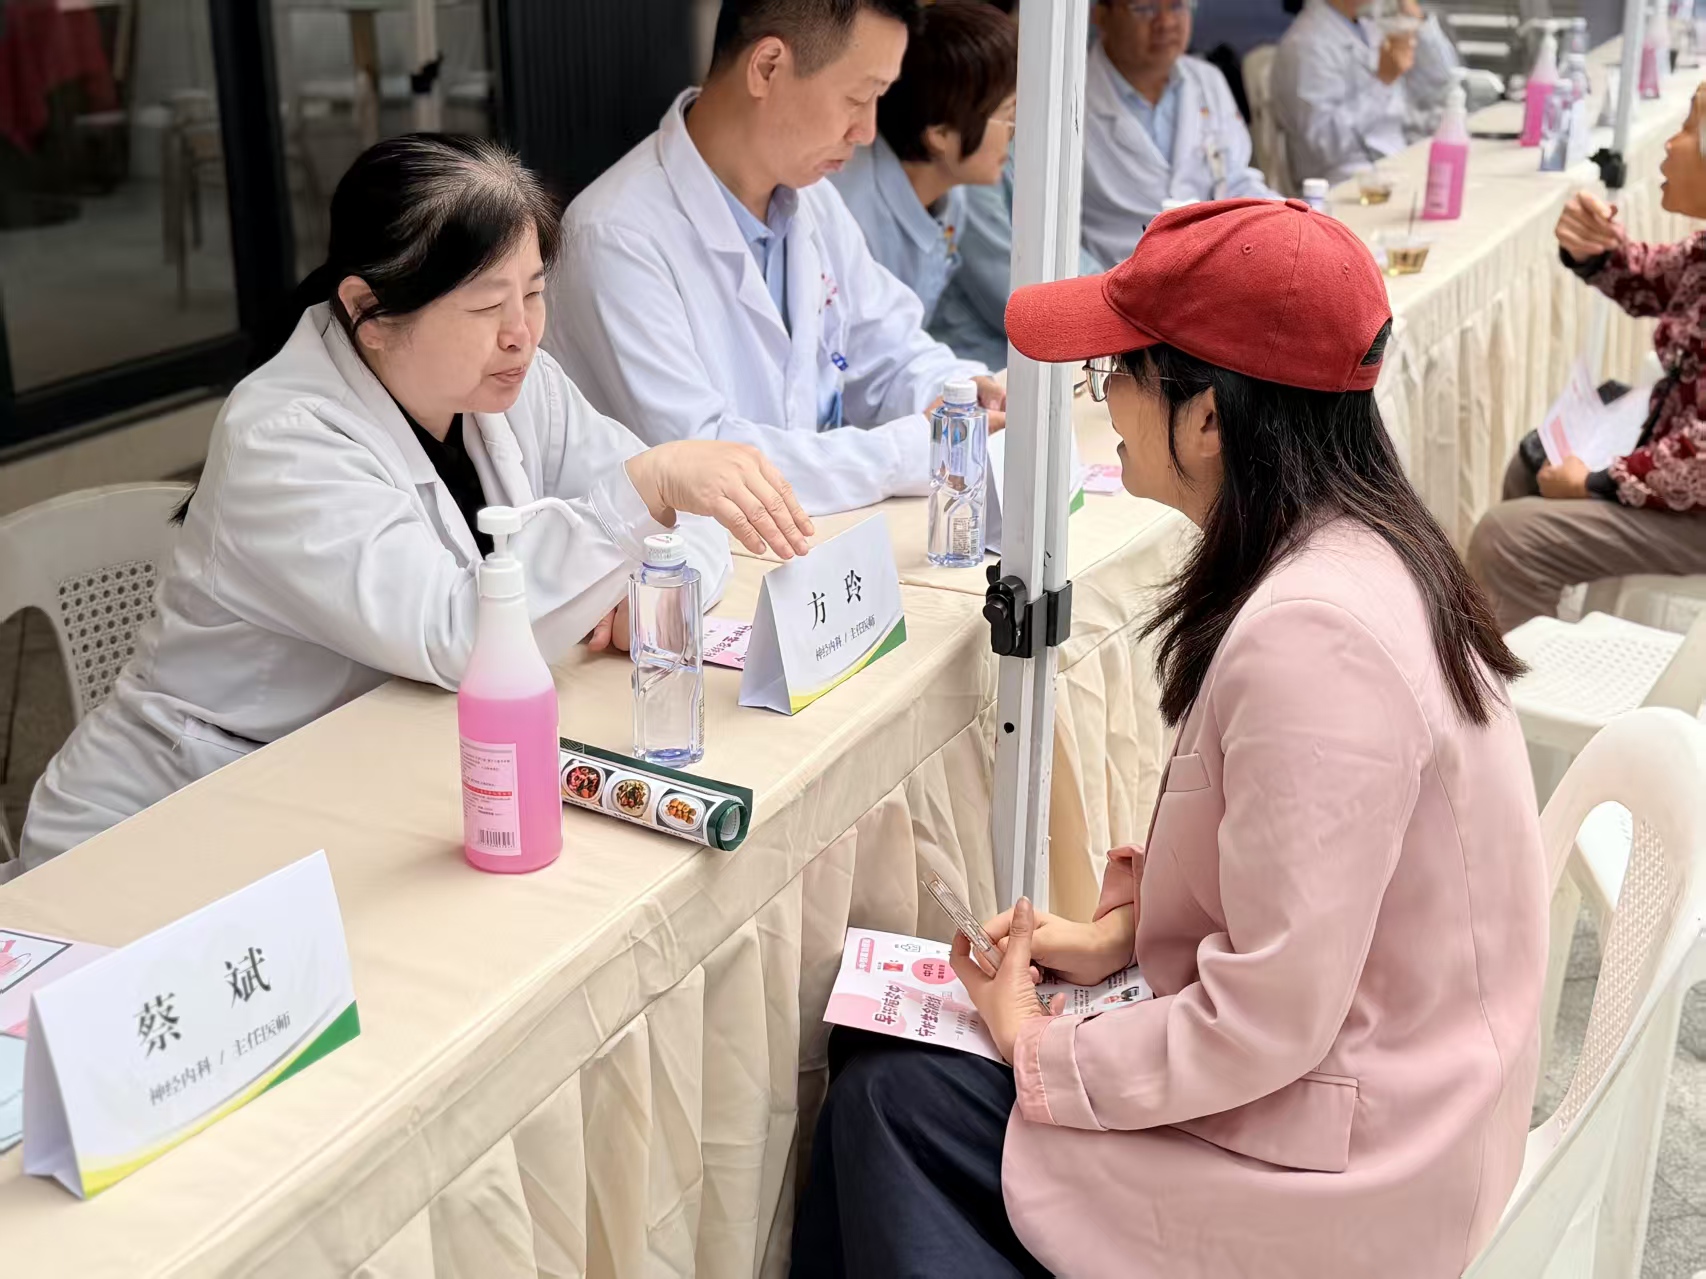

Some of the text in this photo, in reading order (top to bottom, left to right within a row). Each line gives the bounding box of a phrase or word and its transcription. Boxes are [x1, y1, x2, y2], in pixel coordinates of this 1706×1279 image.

[815, 635, 842, 662] 神经内科
[850, 614, 876, 641] 主任医师
[149, 1056, 212, 1107] 神经内科
[234, 1010, 291, 1057] 主任医师
